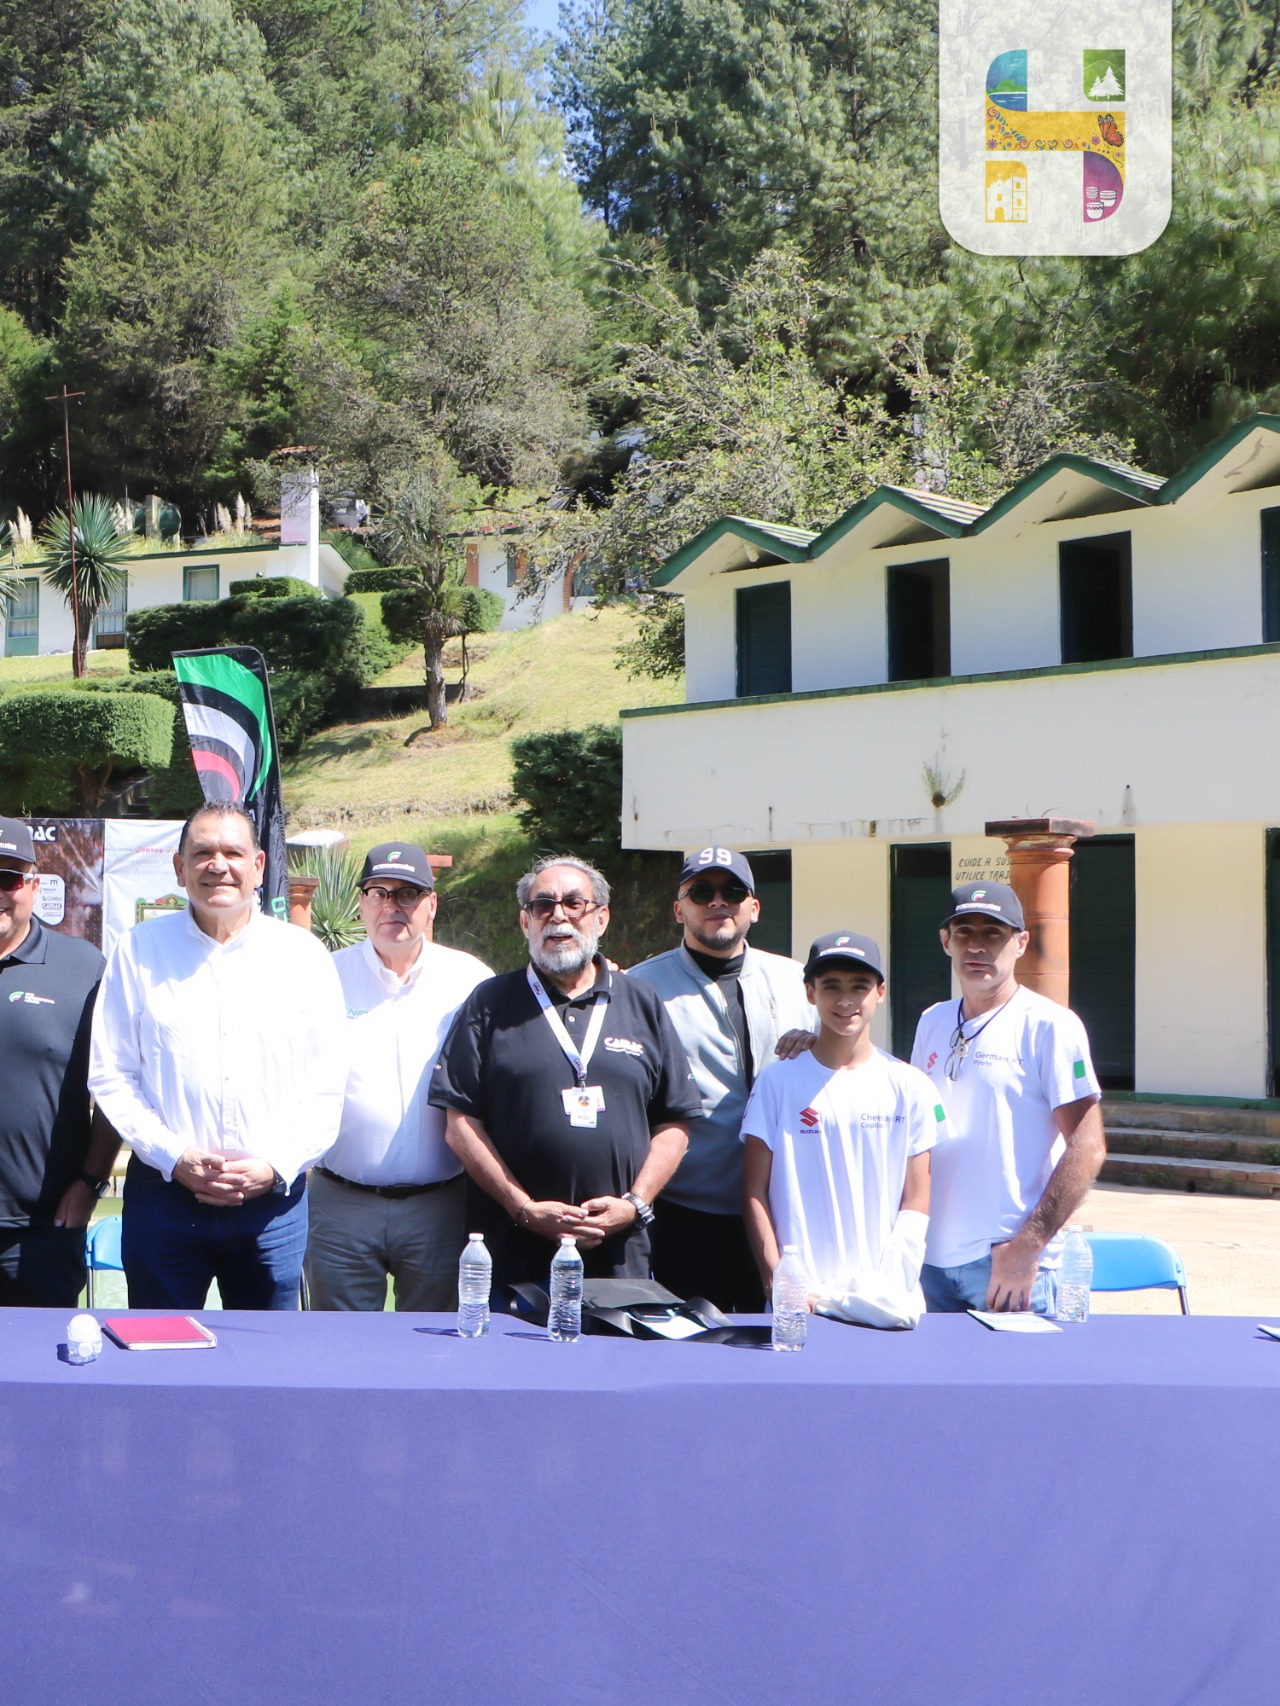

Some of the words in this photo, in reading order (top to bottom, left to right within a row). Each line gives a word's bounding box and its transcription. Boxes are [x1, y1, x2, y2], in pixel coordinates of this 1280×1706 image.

[698, 847, 732, 866] 99
[959, 858, 982, 867] CUIDE
[984, 858, 991, 866] A
[956, 871, 985, 880] UTILICE
[989, 871, 1010, 881] TRAJ
